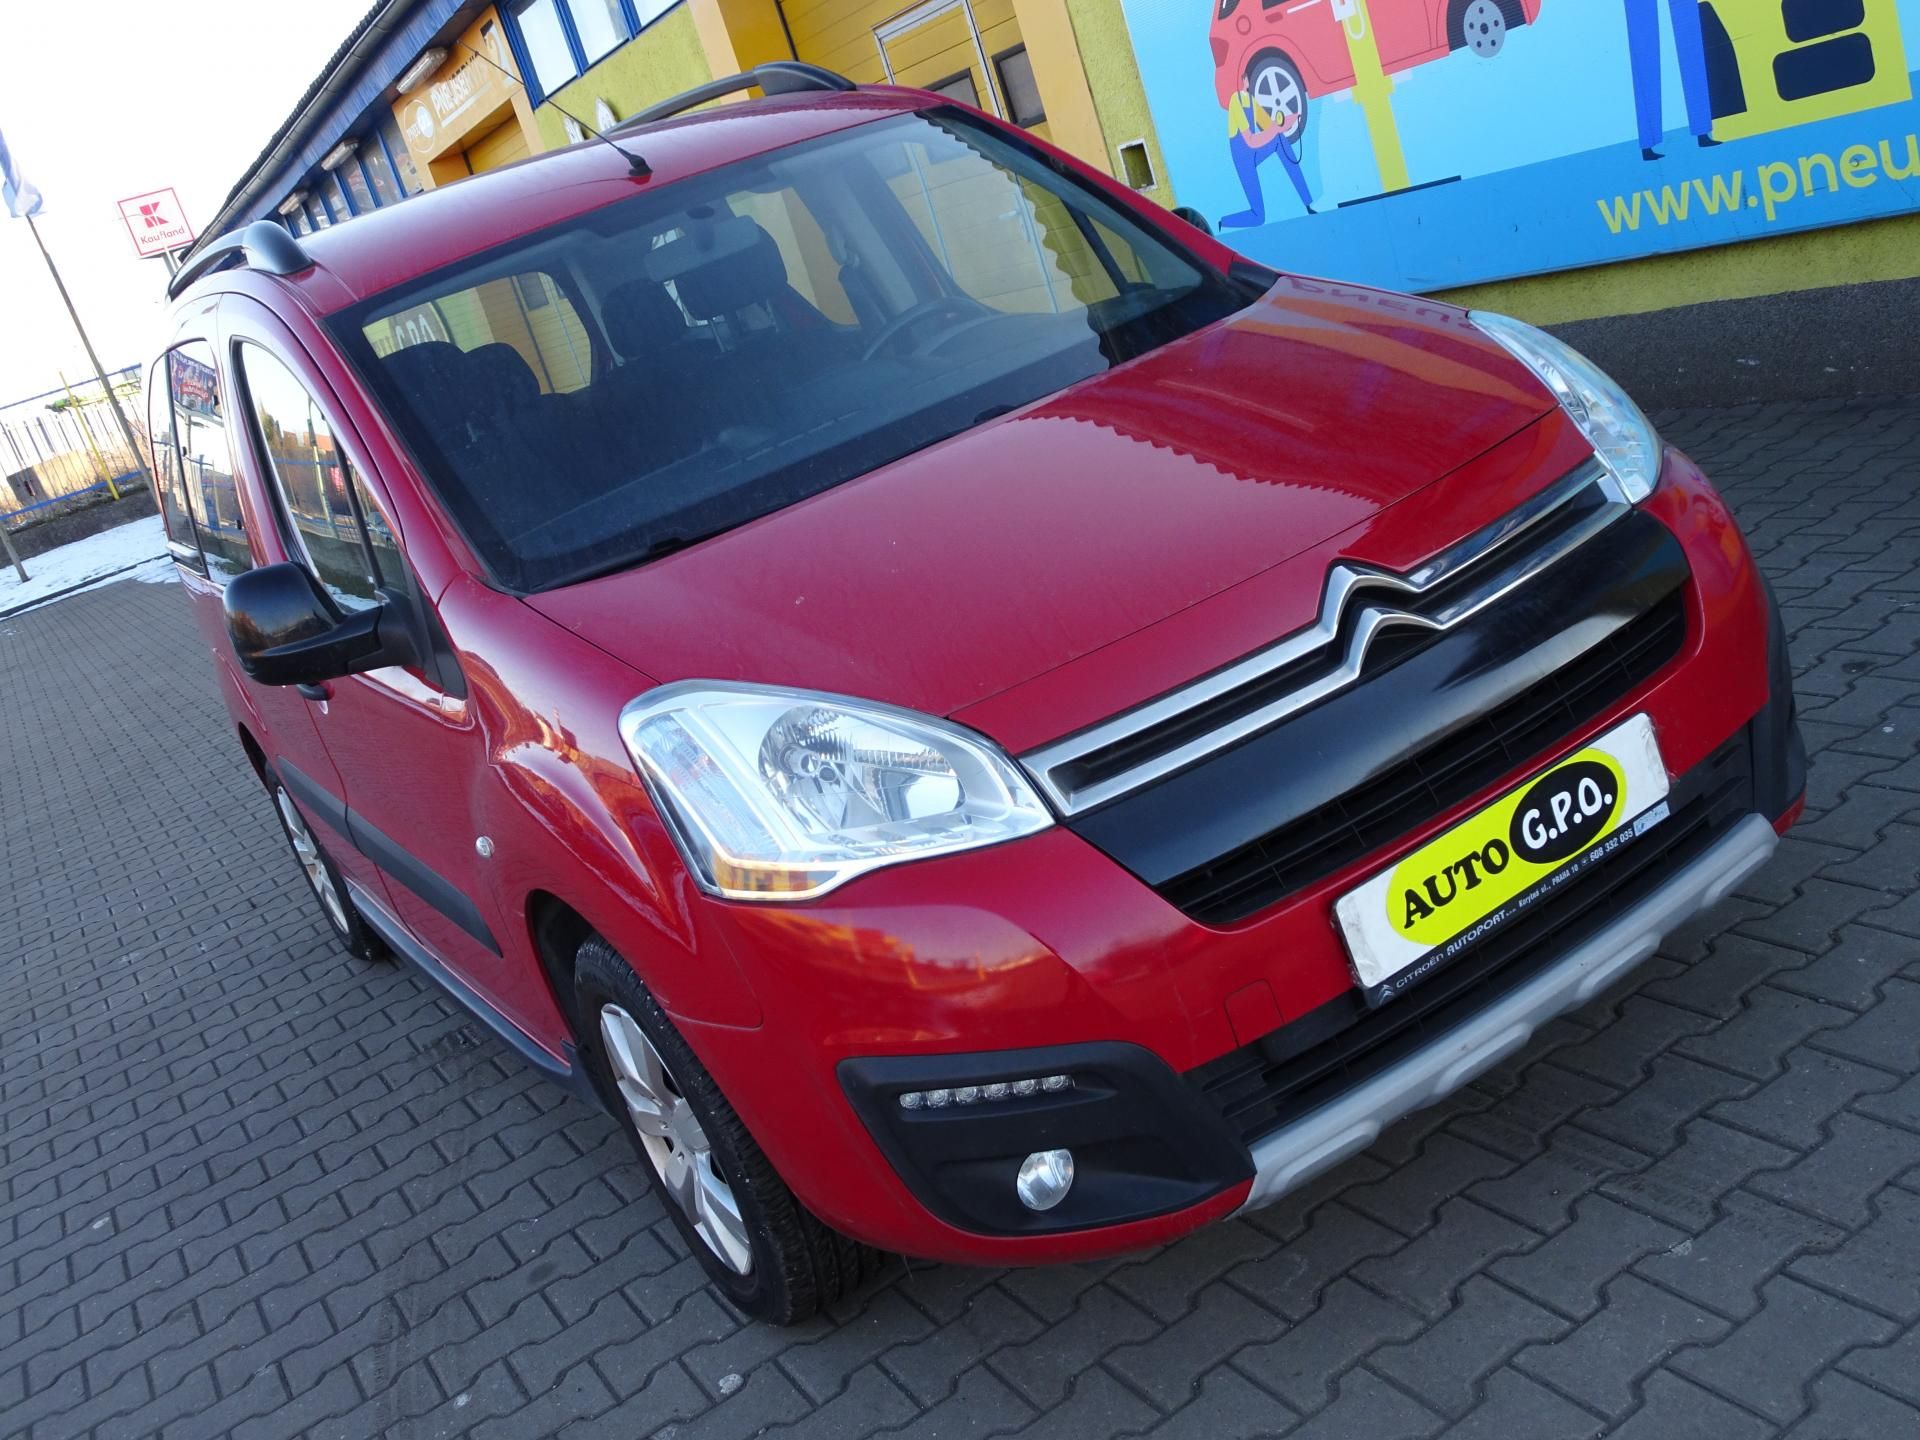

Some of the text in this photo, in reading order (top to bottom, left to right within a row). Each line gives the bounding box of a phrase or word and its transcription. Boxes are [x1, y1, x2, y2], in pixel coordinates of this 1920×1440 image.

[1596, 134, 1920, 234] www.pneu
[140, 225, 185, 244] Kaufland
[1403, 838, 1510, 929] AUTO
[1521, 777, 1613, 850] G.P.O.
[1605, 837, 1619, 852] 332
[1620, 828, 1634, 843] 035
